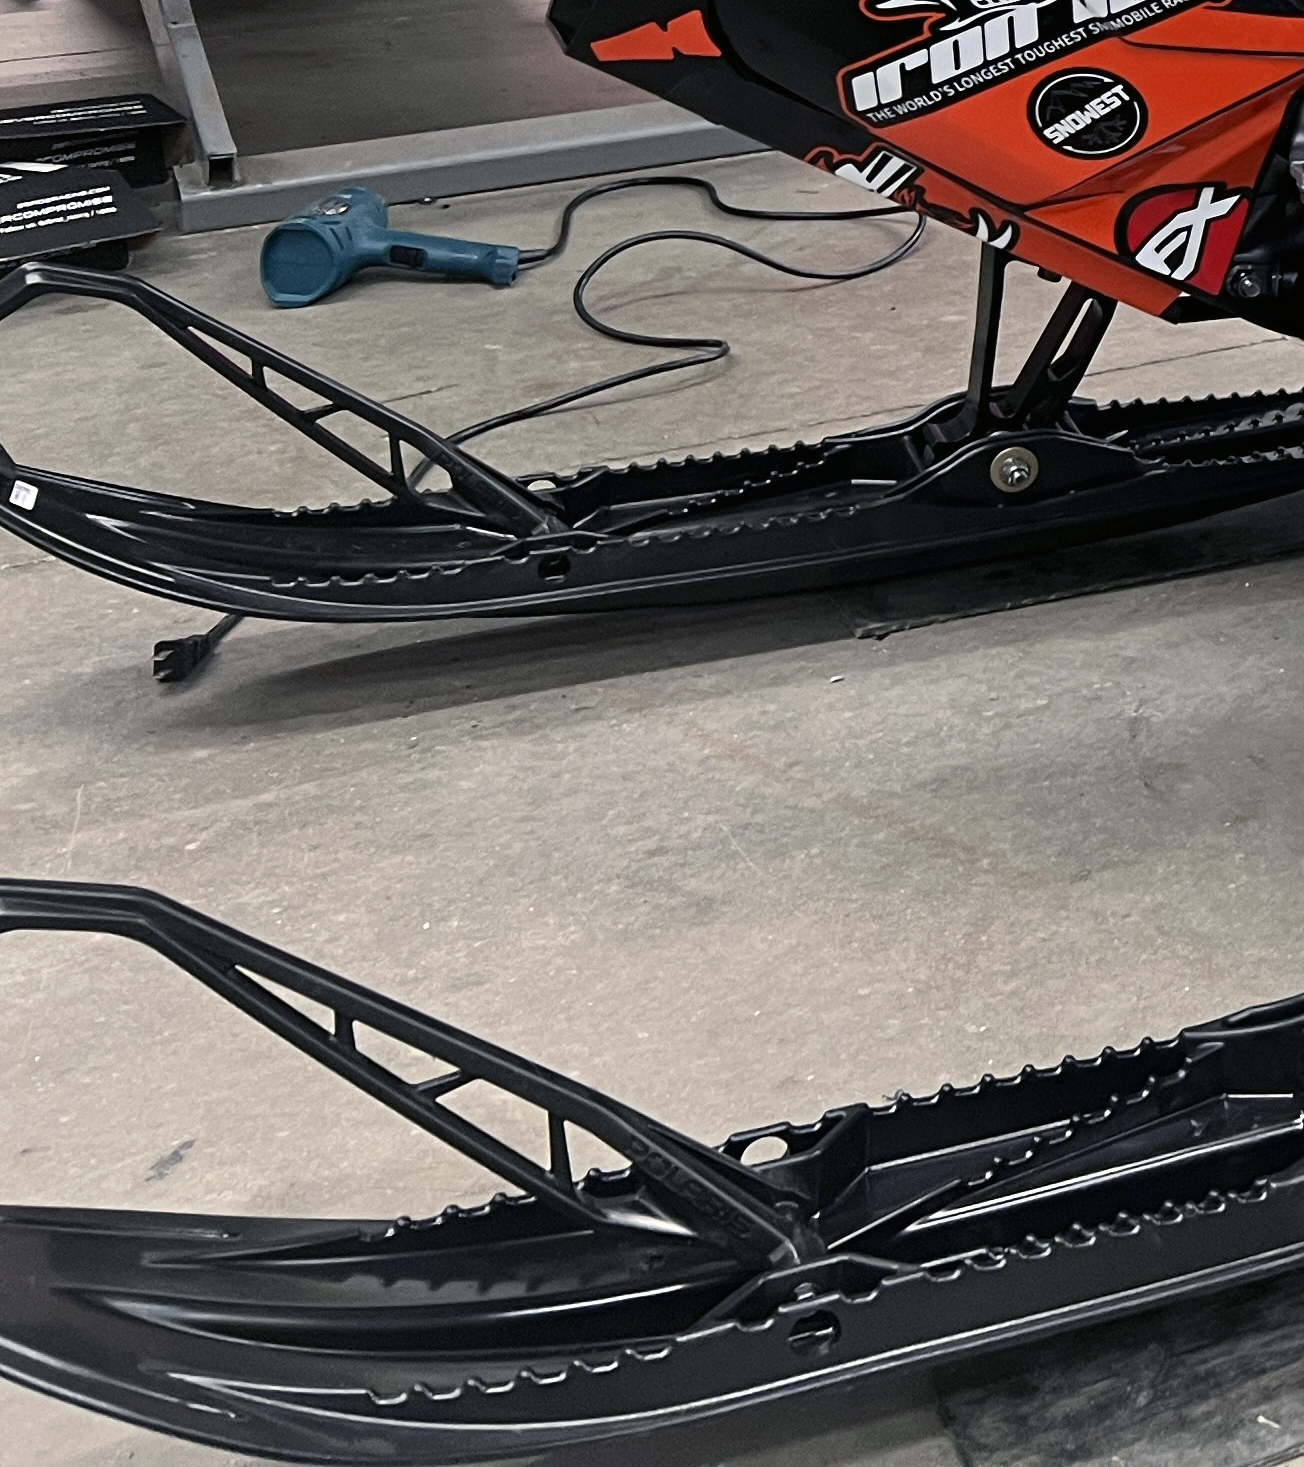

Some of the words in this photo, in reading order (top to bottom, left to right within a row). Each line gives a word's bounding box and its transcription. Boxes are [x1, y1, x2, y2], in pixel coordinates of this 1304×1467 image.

[867, 104, 897, 124] THE
[894, 82, 955, 119] WORLD'S
[954, 57, 1016, 97] LONGEST
[1014, 27, 1088, 66] TOUGHEST
[1042, 84, 1132, 146] SNOWEST
